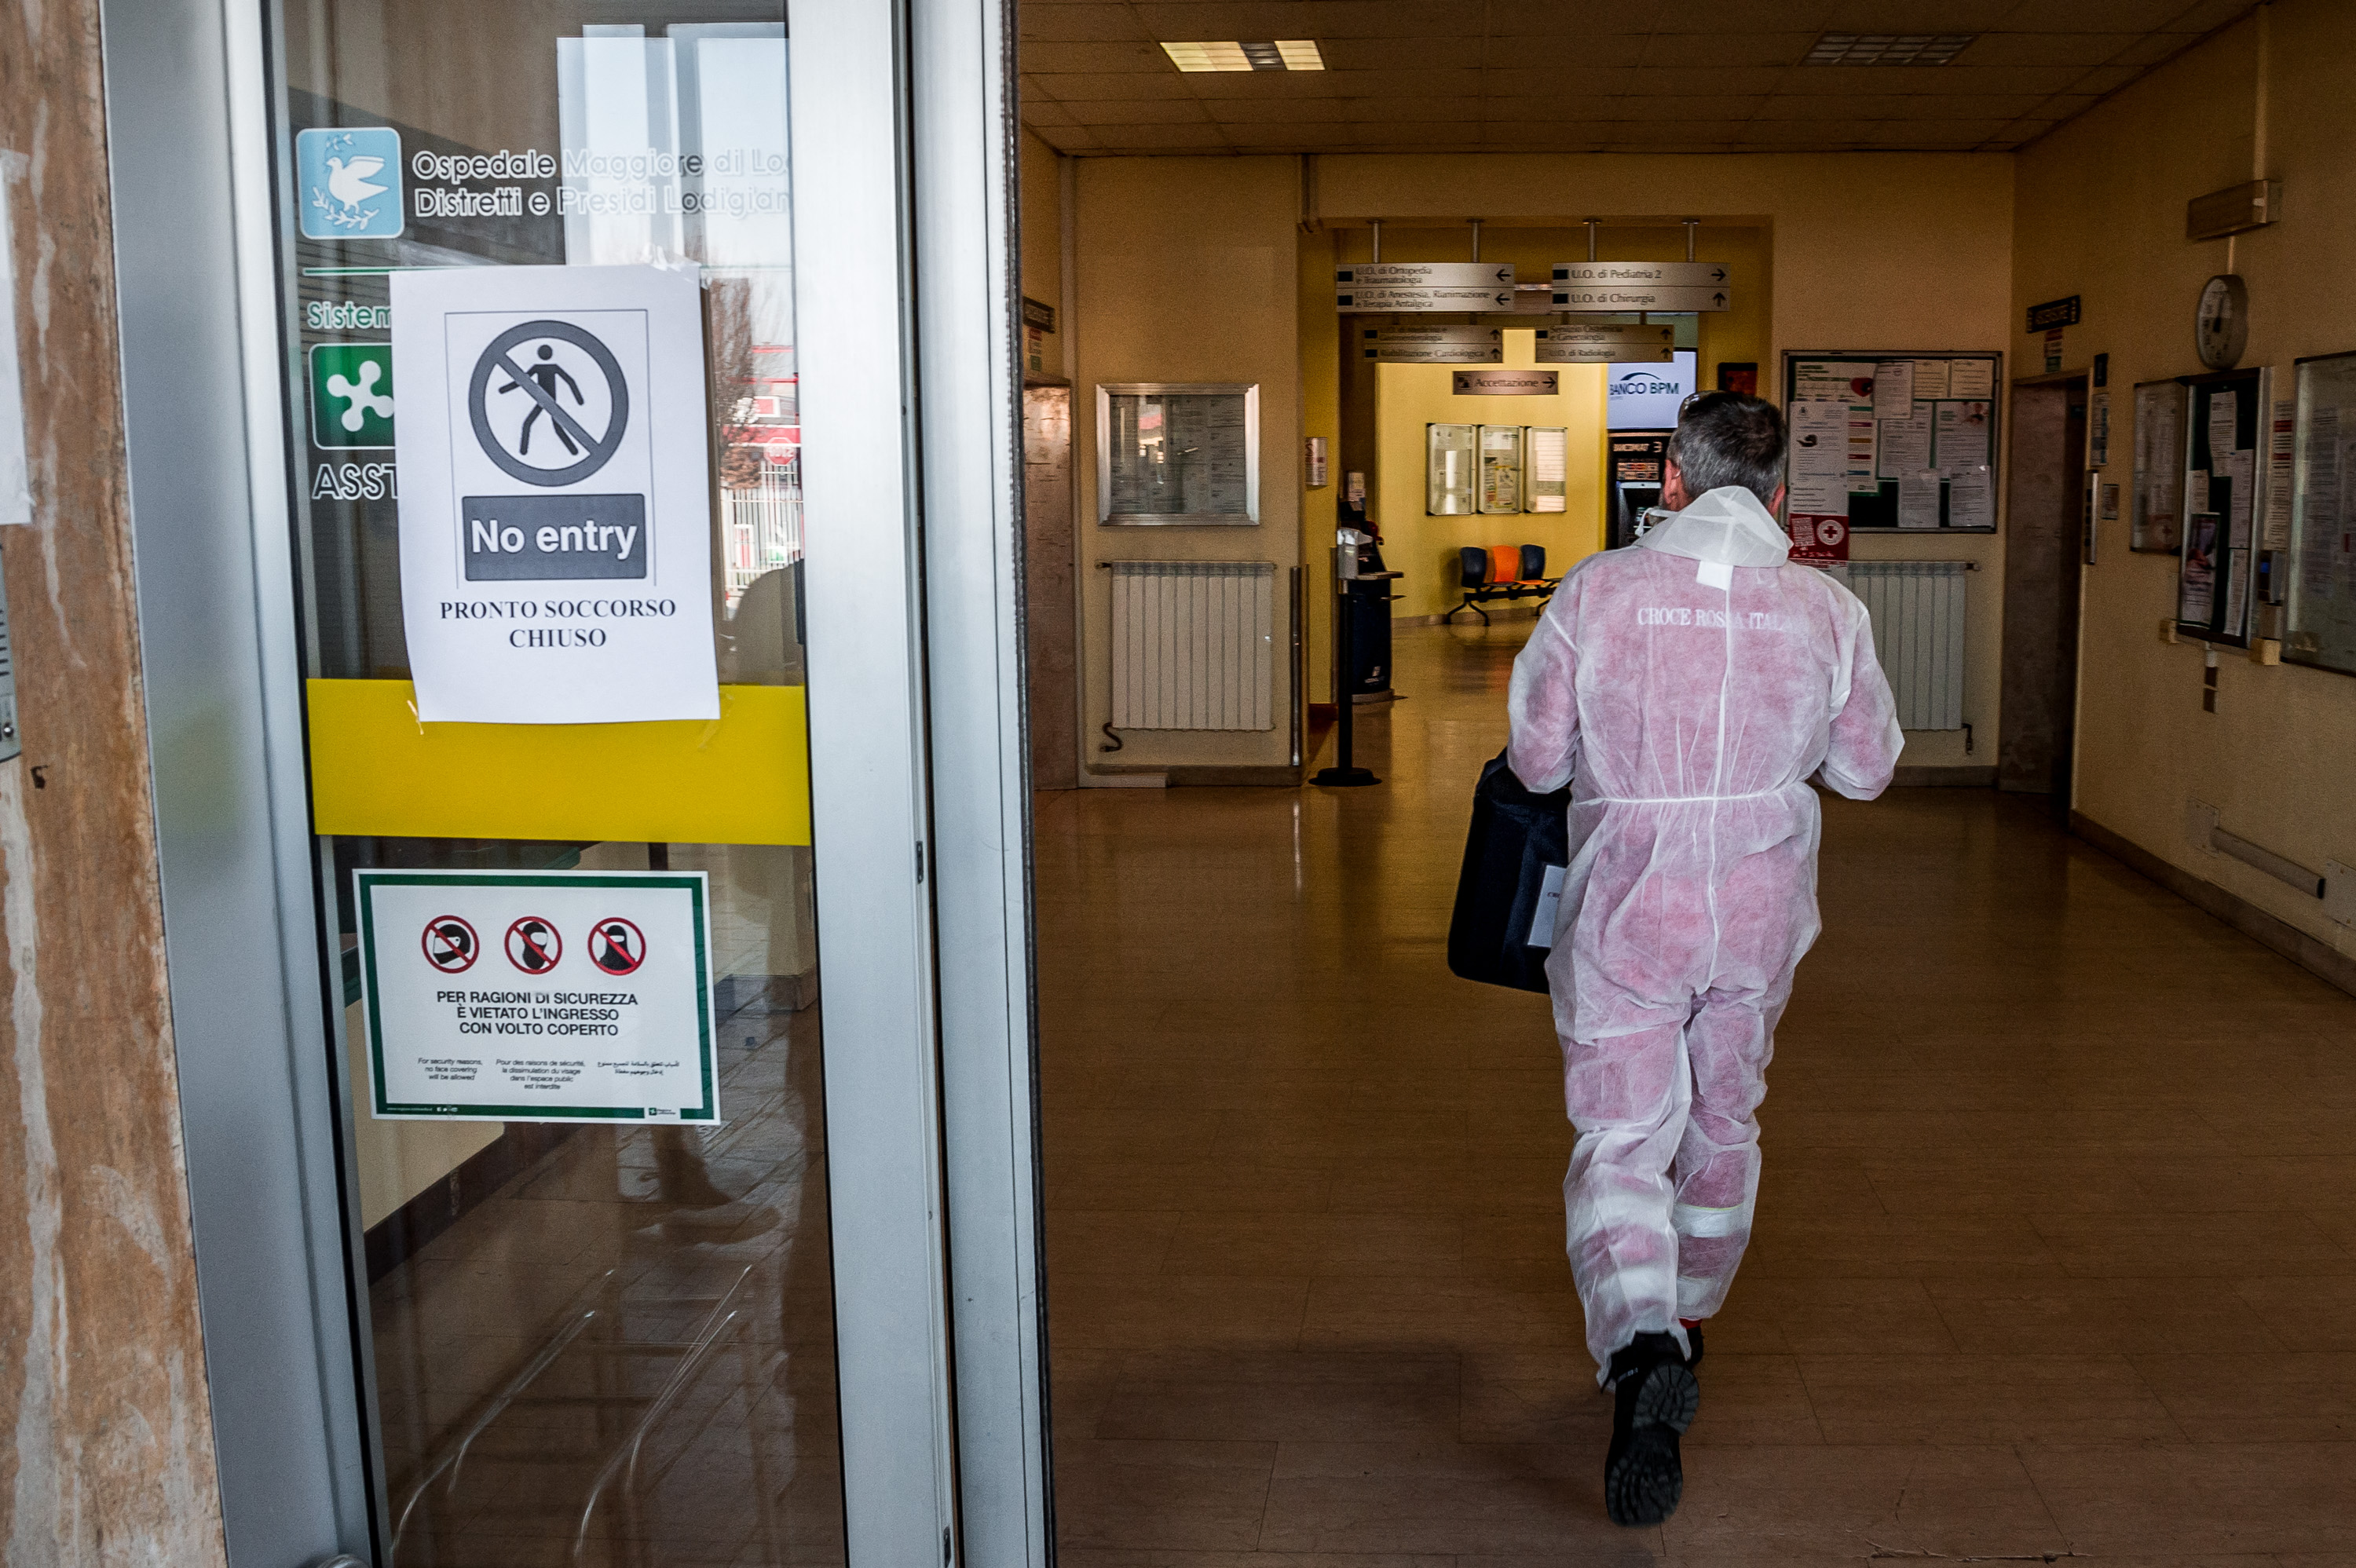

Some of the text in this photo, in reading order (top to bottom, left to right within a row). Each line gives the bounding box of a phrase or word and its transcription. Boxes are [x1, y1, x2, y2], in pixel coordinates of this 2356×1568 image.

[412, 148, 788, 185] Ospedale Maggiore di Lo
[415, 188, 522, 217] Distretti
[529, 192, 551, 216] e
[557, 185, 657, 215] Presidi
[1377, 266, 1387, 275] di
[1571, 269, 1663, 280] U.O. di Pediatria 2
[1377, 290, 1387, 299] di
[1571, 292, 1656, 305] U.O. di Chirurgia
[1475, 378, 1539, 388] Accettazione
[1649, 382, 1679, 395] BPM
[471, 518, 638, 561] No entry
[440, 598, 677, 620] PRONTO SOCCORSO
[1637, 607, 1692, 626] CROCE
[1694, 609, 1745, 629] ROSA
[509, 628, 607, 648] CHIUSO
[437, 991, 638, 1006] PER RAGIONI DI SICUREZZA
[457, 1003, 620, 1021] È VIETATO L'INGRESSO
[459, 1022, 619, 1036] CON VOLTO COPERTO
[449, 1066, 477, 1075] covering
[561, 1068, 581, 1076] visage
